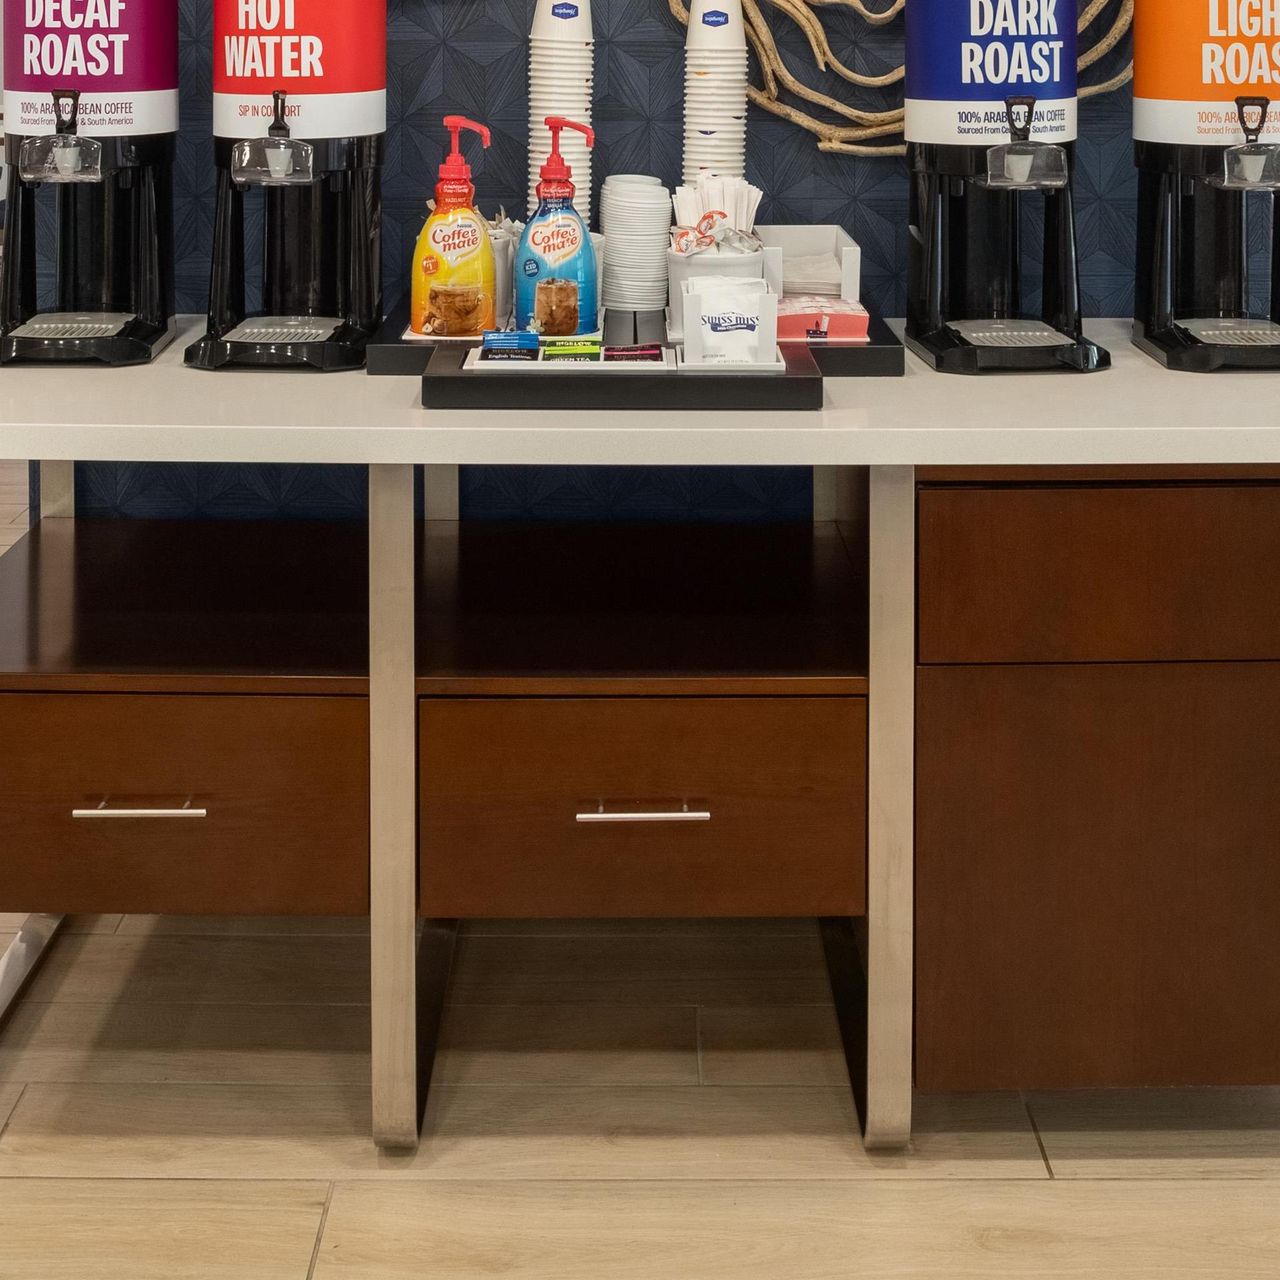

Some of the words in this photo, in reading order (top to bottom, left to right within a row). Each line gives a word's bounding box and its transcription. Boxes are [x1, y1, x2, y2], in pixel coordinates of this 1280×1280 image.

[23, 33, 129, 76] ROAST
[224, 35, 324, 77] WATER
[961, 41, 1064, 84] ROAST
[20, 102, 39, 114] 100%
[39, 103, 74, 115] ARAICA
[79, 102, 102, 115] BEAN
[104, 102, 134, 114] COFFEE
[238, 105, 250, 117] SIP
[251, 105, 260, 116] IN
[261, 105, 301, 117] COORT
[958, 111, 982, 123] 100%
[983, 111, 1021, 123] ARABCA
[1023, 110, 1045, 122] BAN
[1046, 108, 1066, 121] COFFEE
[20, 117, 40, 125] Sourced
[40, 117, 55, 126] From
[80, 118, 86, 126] &
[87, 117, 107, 126] South
[107, 117, 134, 125] America
[1197, 111, 1222, 123] 100%
[1224, 110, 1261, 123] ARBICA
[957, 126, 982, 134] Sourced
[984, 126, 1000, 134] From
[1031, 124, 1049, 134] South
[1197, 126, 1223, 134] Sourced
[1224, 126, 1241, 134] From
[432, 228, 477, 244] Coffee
[531, 228, 576, 246] Coffee
[442, 236, 478, 252] mate
[543, 236, 578, 254] mate
